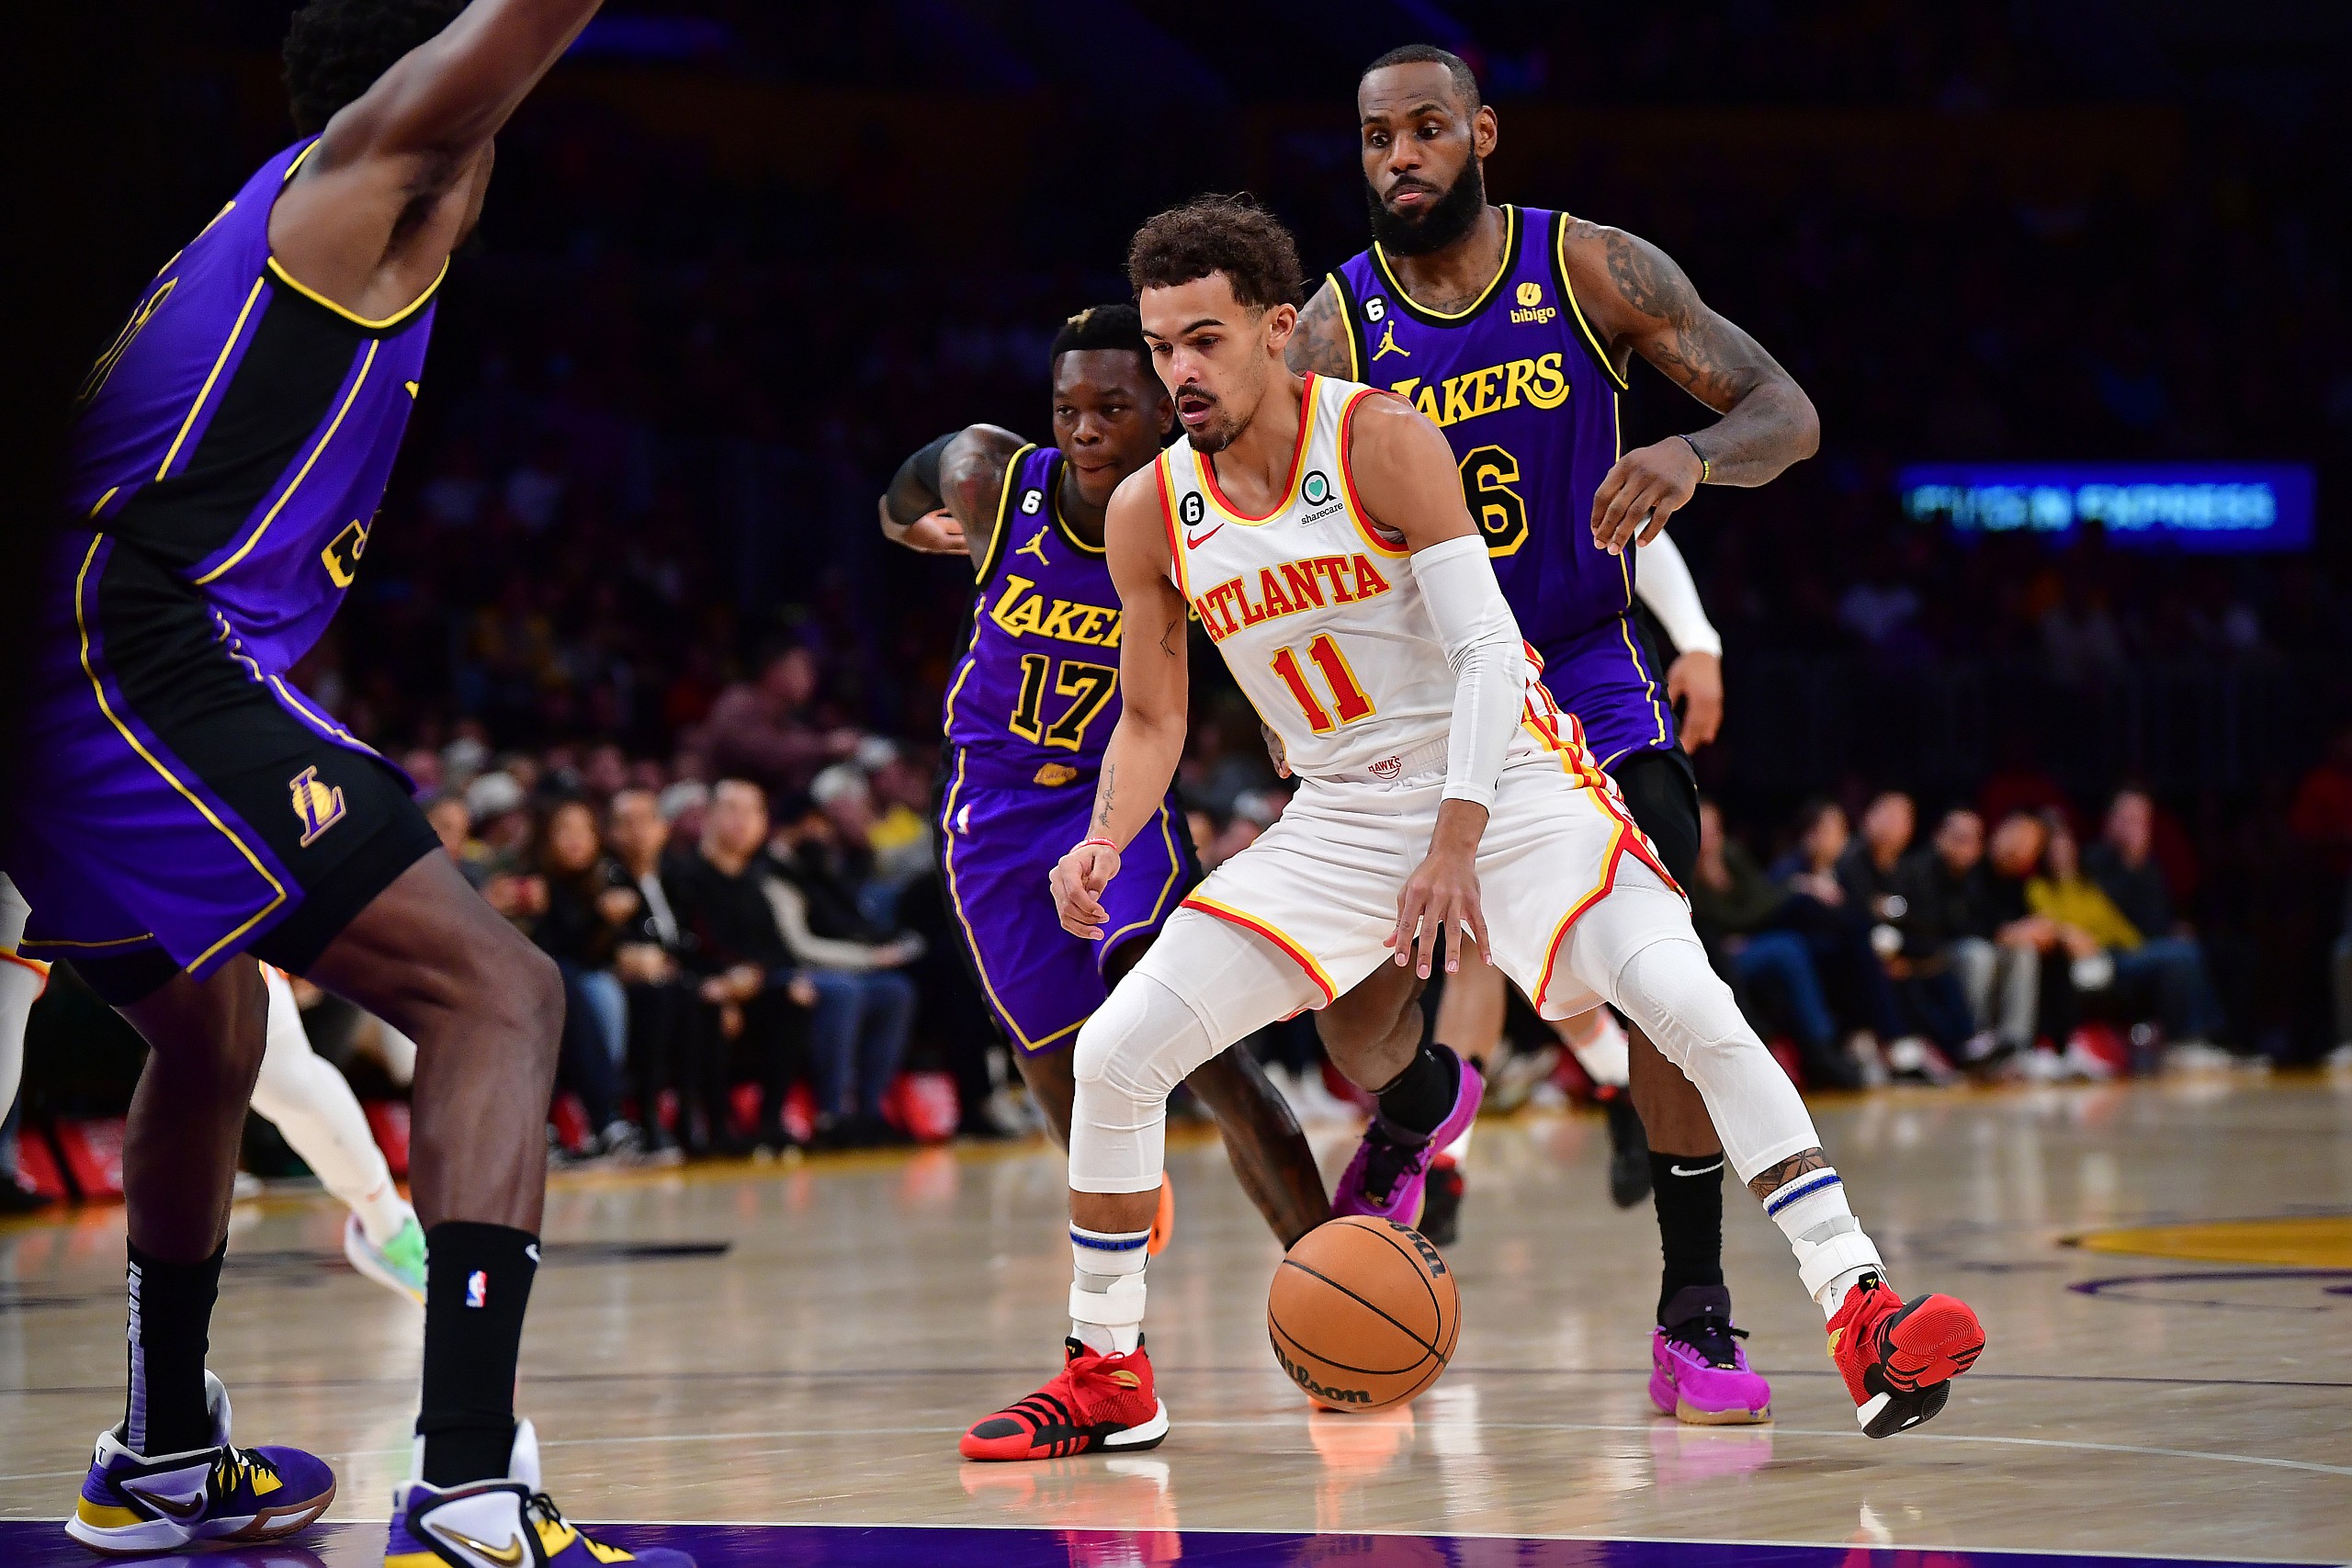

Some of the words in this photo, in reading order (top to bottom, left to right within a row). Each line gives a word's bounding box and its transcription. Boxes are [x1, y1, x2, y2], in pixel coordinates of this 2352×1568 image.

[1366, 298, 1385, 321] 6
[1510, 308, 1556, 324] bibigo
[1022, 490, 1043, 514] 6
[1185, 496, 1200, 523] 6
[1301, 502, 1344, 525] sharecare
[1458, 445, 1529, 558] 6
[989, 573, 1123, 649] LAKE
[1194, 552, 1392, 645] ATLANTA
[1008, 653, 1118, 752] 17
[1269, 632, 1377, 734] 11
